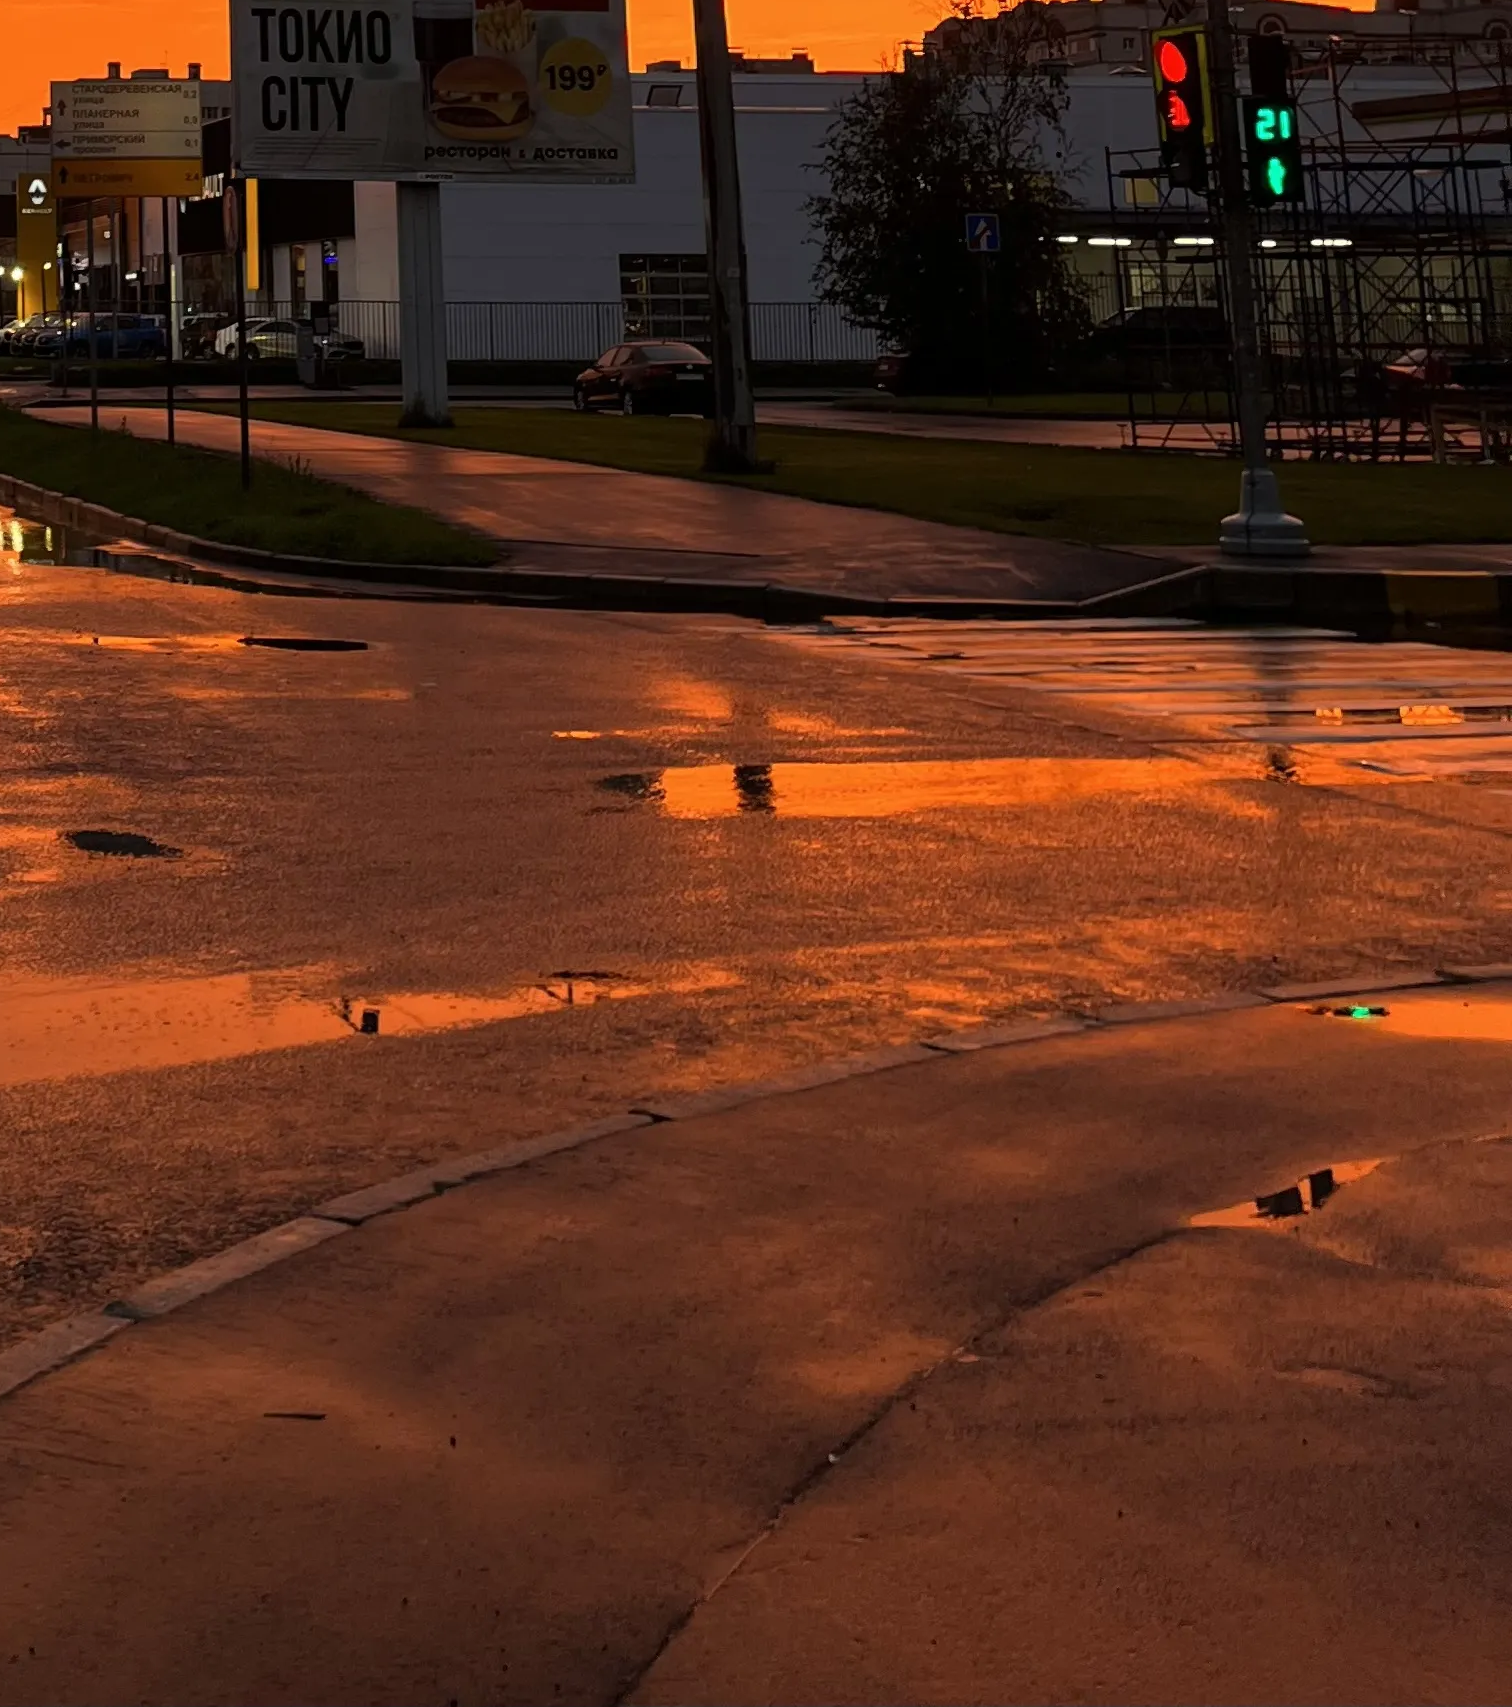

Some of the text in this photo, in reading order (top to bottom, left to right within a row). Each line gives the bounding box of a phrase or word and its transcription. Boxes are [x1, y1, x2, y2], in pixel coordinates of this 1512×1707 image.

[251, 8, 391, 64] ТОКИО
[262, 75, 354, 132] CITY
[1255, 107, 1291, 141] 21
[424, 144, 511, 162] ресторан
[533, 147, 618, 161] доставка
